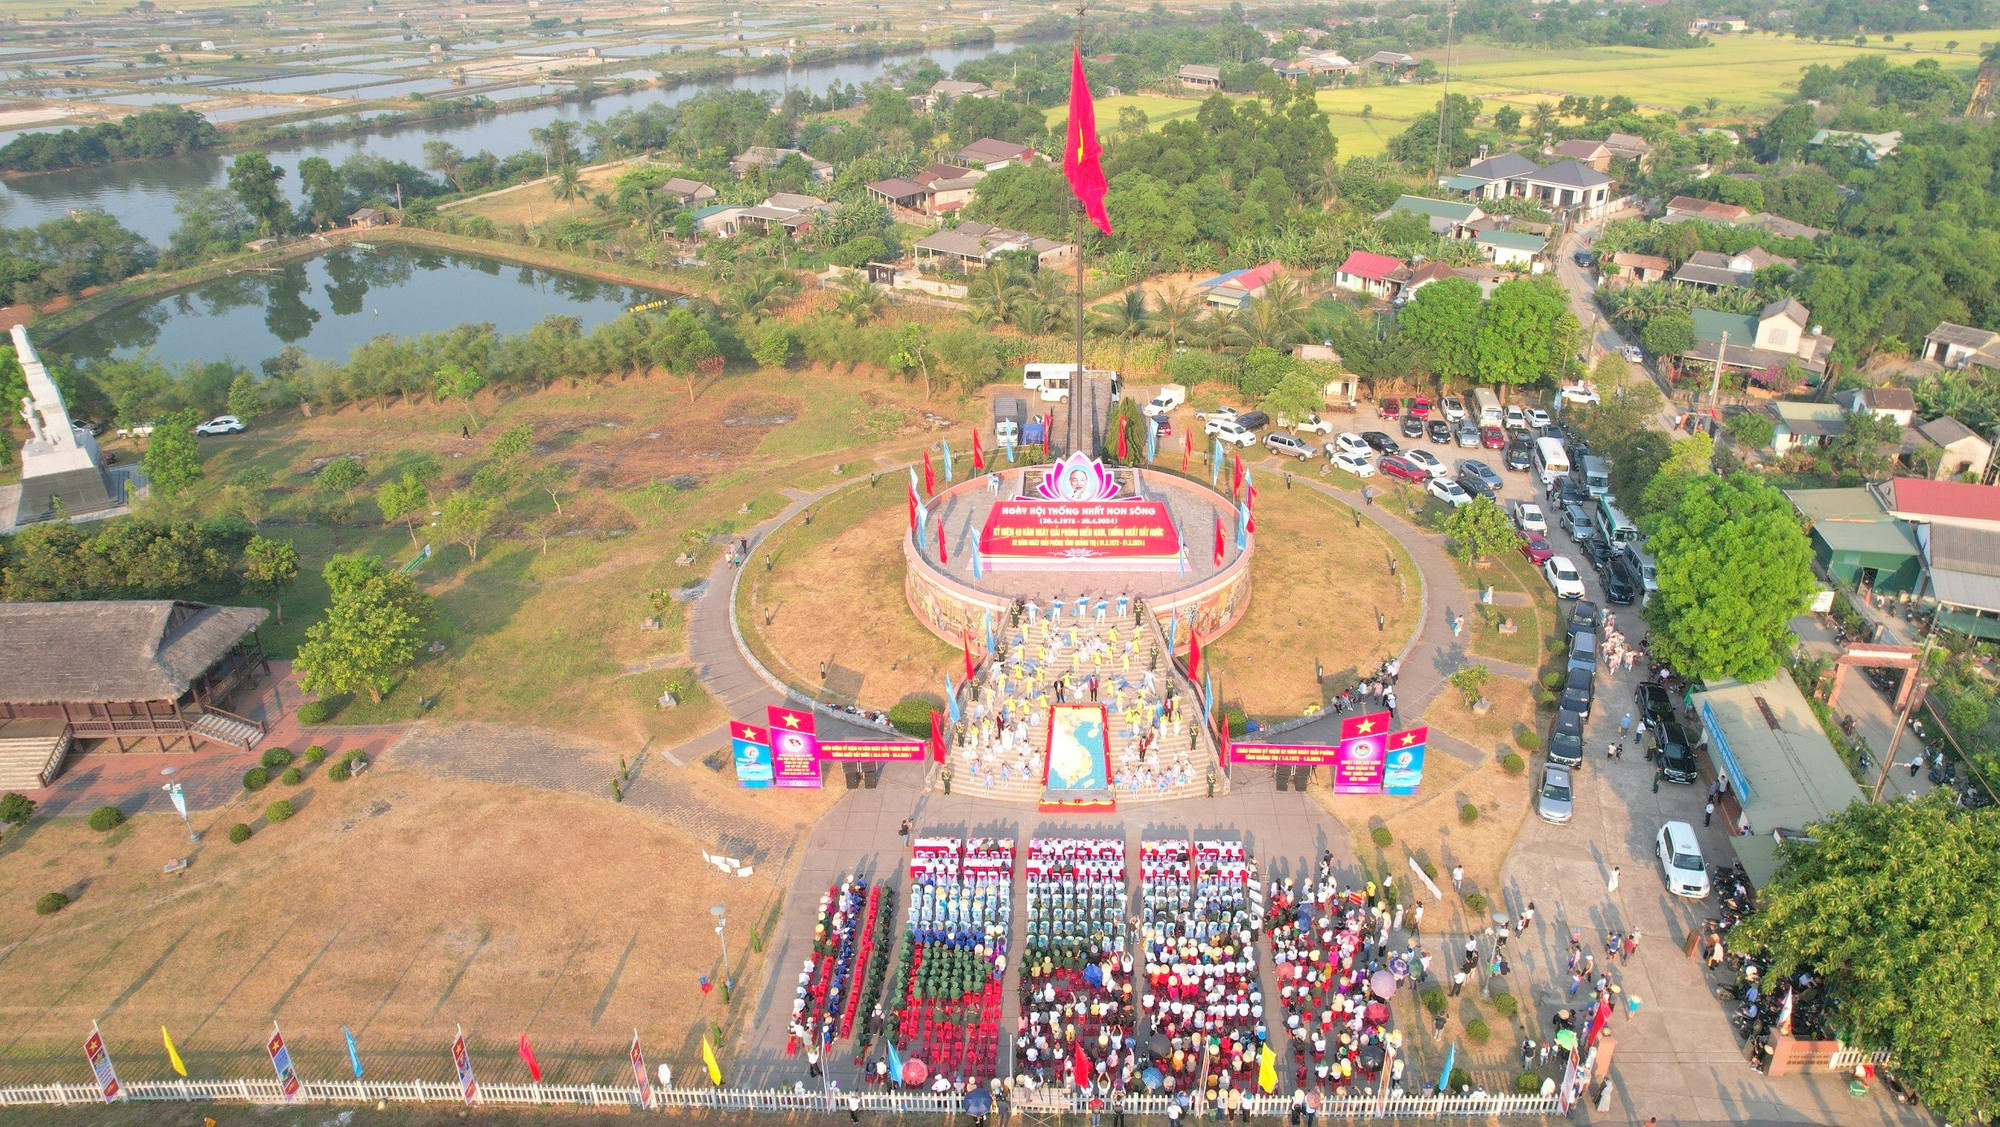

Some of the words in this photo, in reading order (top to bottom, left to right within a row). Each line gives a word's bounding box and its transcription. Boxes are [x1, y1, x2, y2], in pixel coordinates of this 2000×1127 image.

[1002, 506, 1027, 515] NGÀY
[1029, 506, 1046, 517] HỘI
[1047, 504, 1079, 515] THỐNG
[1082, 504, 1105, 515] NHẤT
[1129, 506, 1156, 515] SÔNG
